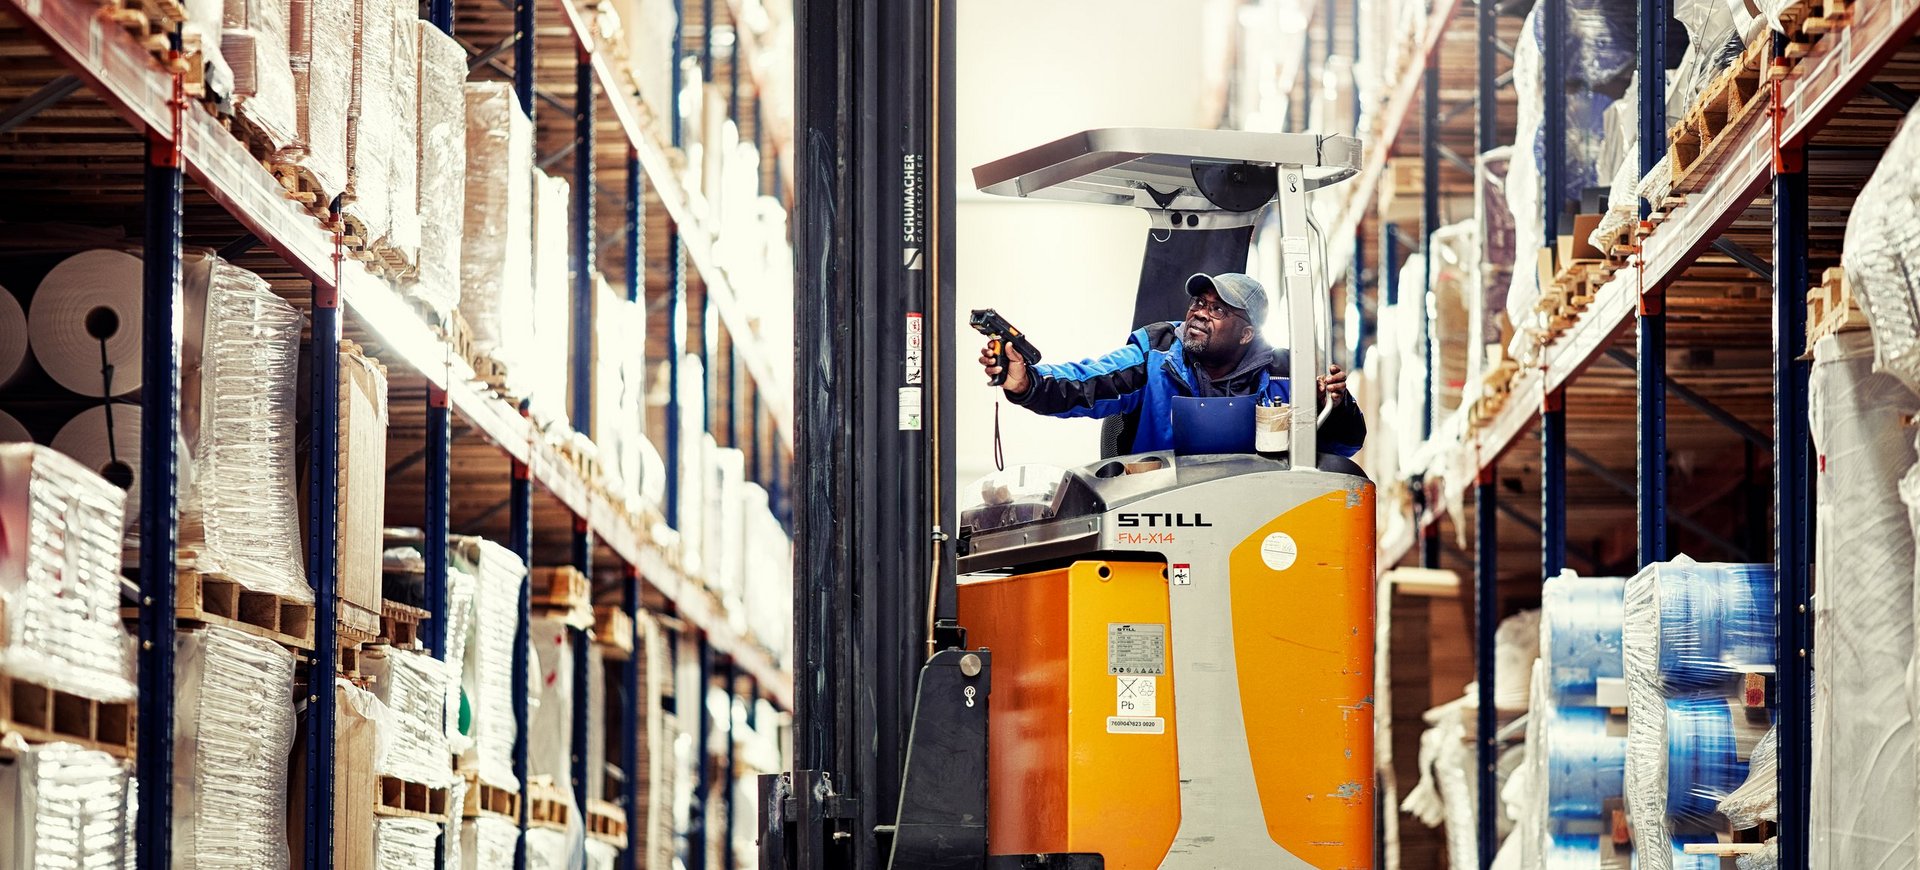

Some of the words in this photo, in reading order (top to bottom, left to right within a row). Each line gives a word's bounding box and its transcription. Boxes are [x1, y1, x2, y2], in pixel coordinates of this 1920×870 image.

[904, 154, 915, 242] SCHUMACHER
[1298, 262, 1304, 271] 5
[1118, 513, 1212, 527] STILL
[1118, 532, 1174, 544] FM-X14
[1121, 700, 1135, 710] Pb
